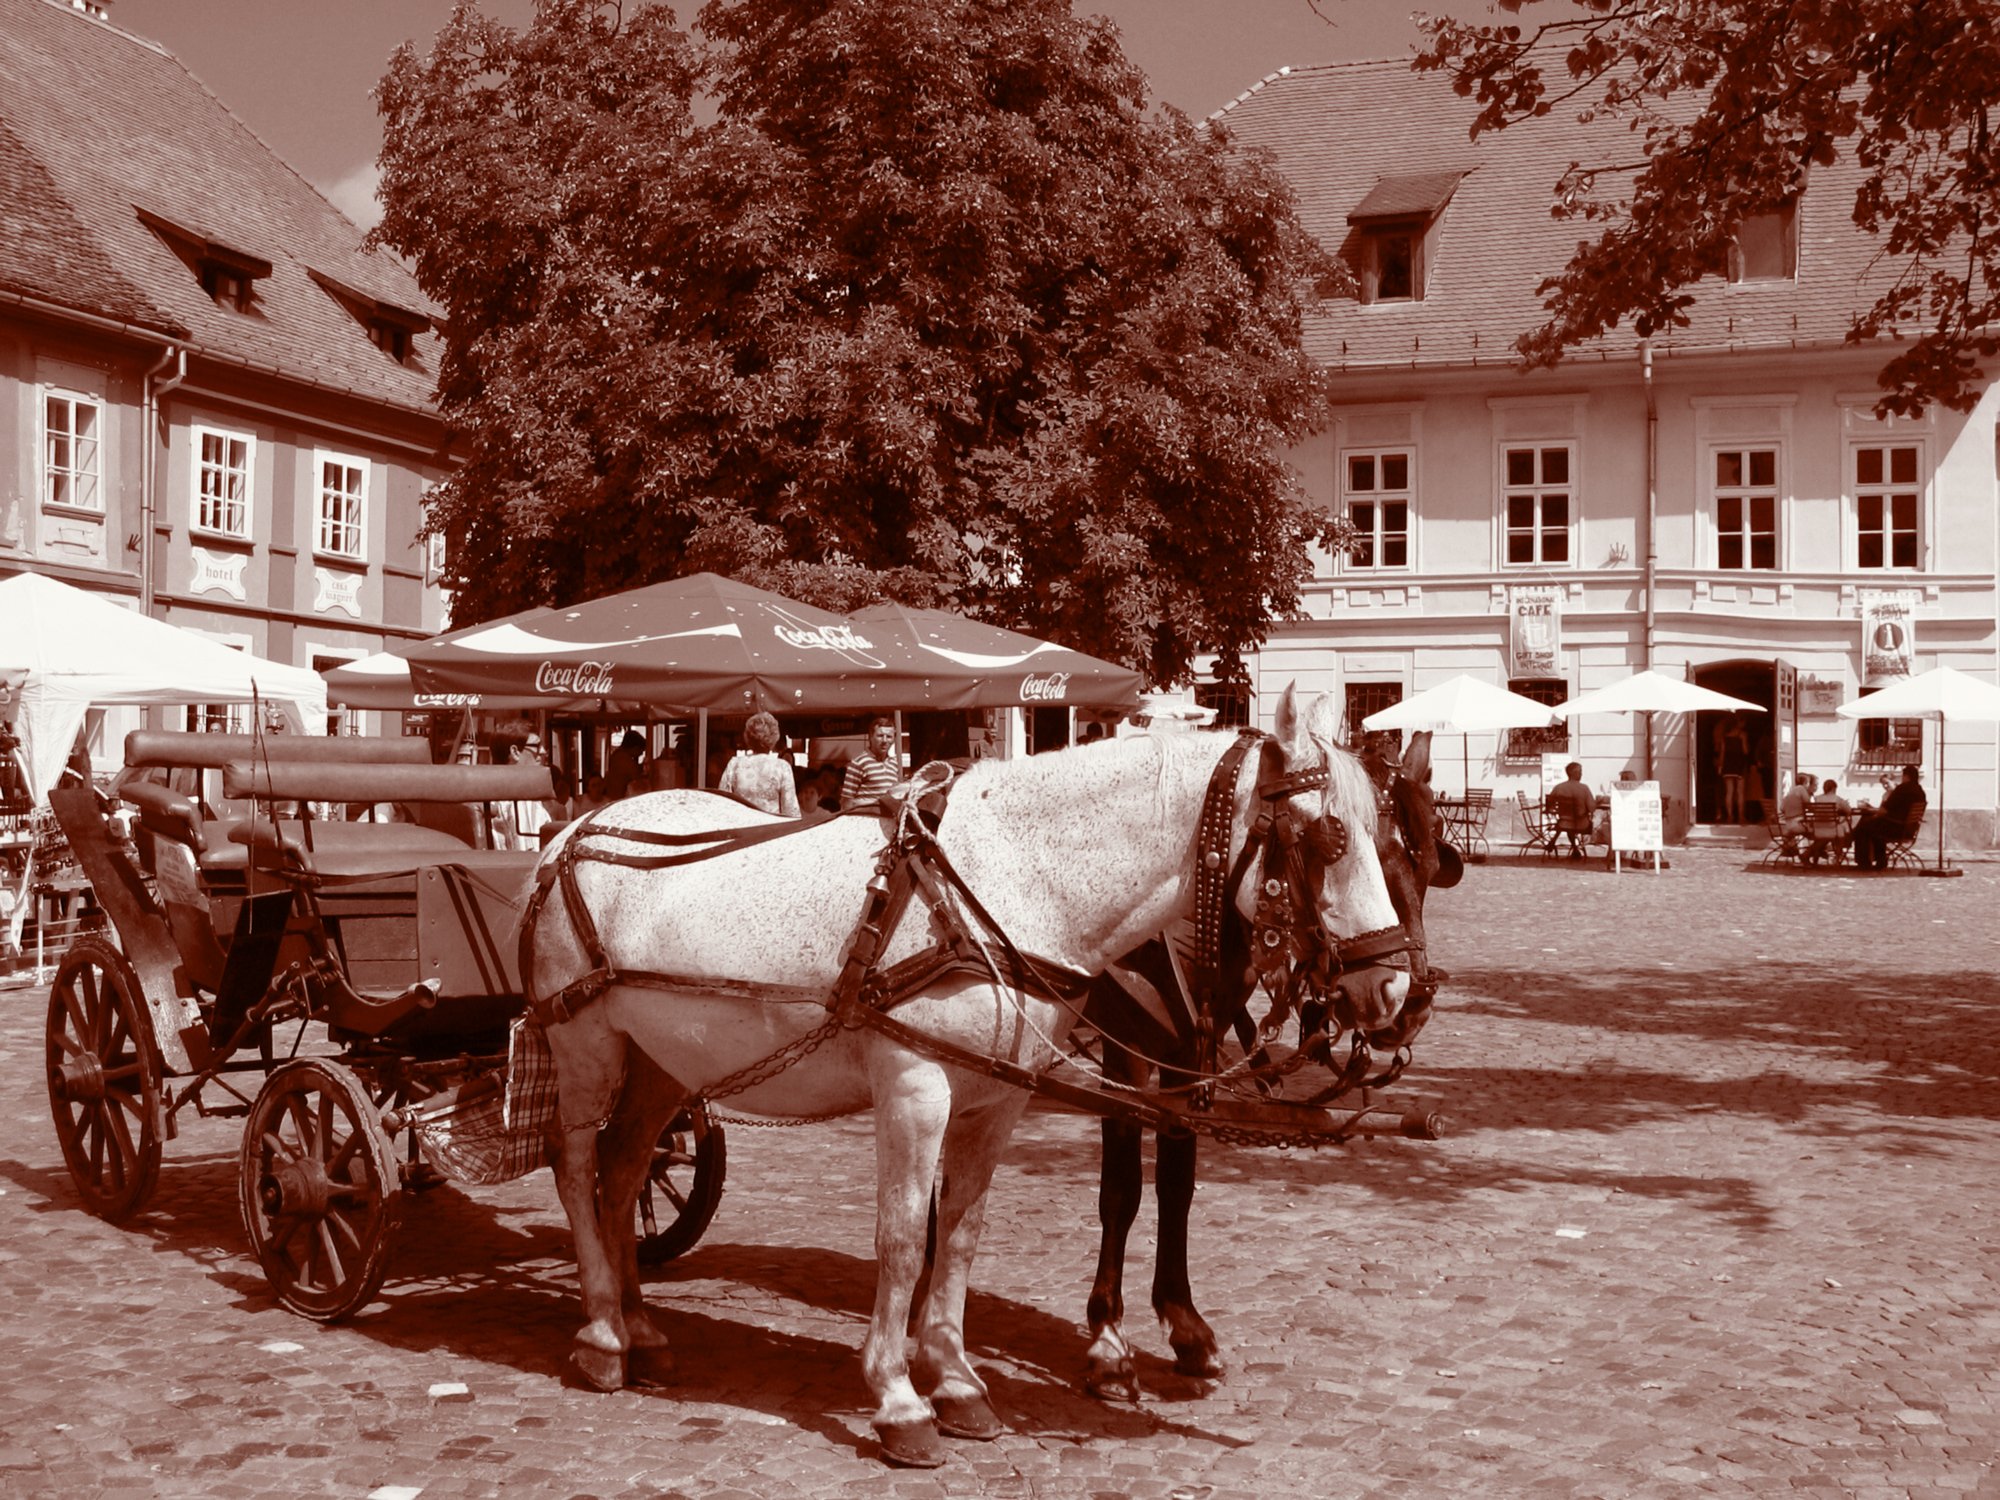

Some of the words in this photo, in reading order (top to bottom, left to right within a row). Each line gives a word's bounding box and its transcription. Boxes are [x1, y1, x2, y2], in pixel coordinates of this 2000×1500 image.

[206, 565, 233, 581] hotel
[1518, 604, 1551, 616] CAFE
[774, 625, 873, 650] Coca-Cola
[535, 661, 616, 694] Coca-Cola
[1020, 672, 1072, 701] Coca-Cola
